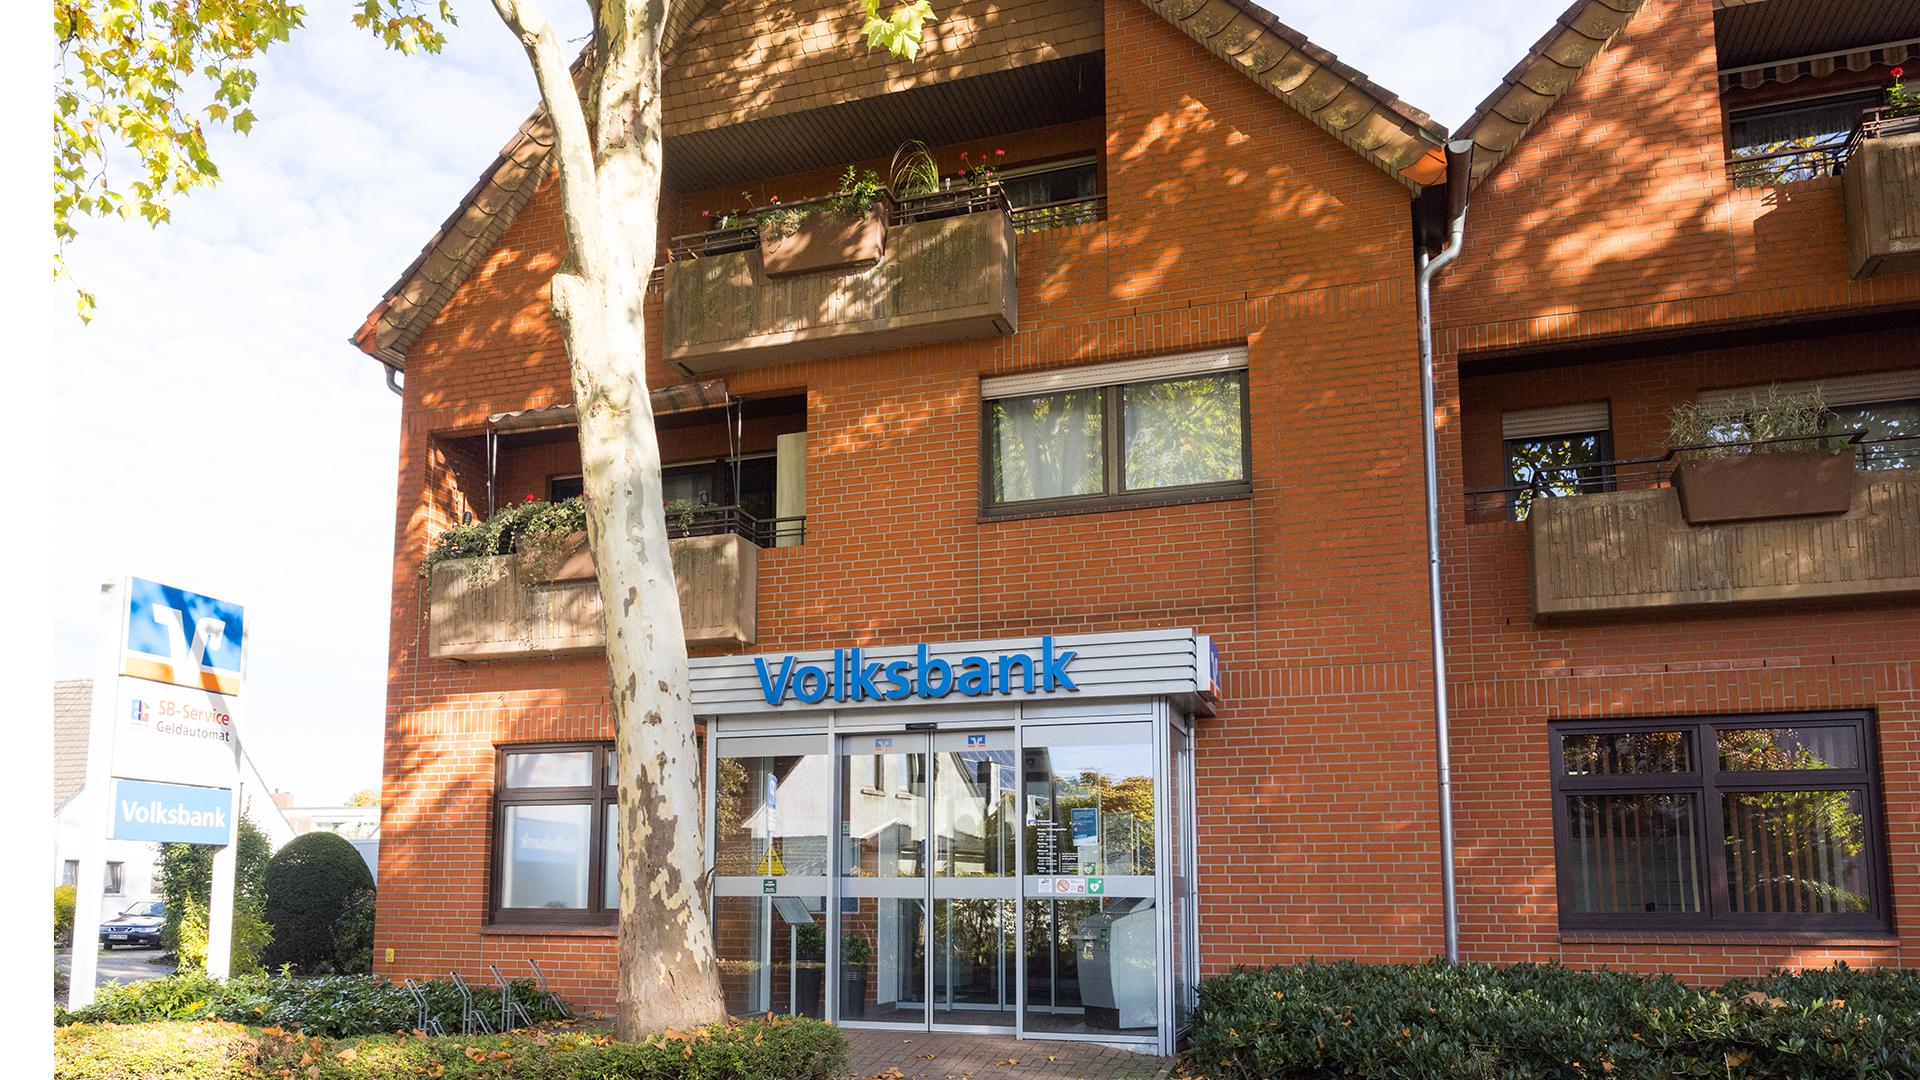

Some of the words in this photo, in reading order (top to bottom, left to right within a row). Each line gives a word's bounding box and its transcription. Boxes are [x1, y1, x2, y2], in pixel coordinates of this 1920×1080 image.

[753, 635, 1080, 705] Volksbank
[158, 700, 230, 726] SB-Service
[157, 721, 230, 742] Geldautomat
[121, 799, 226, 829] Volksbank
